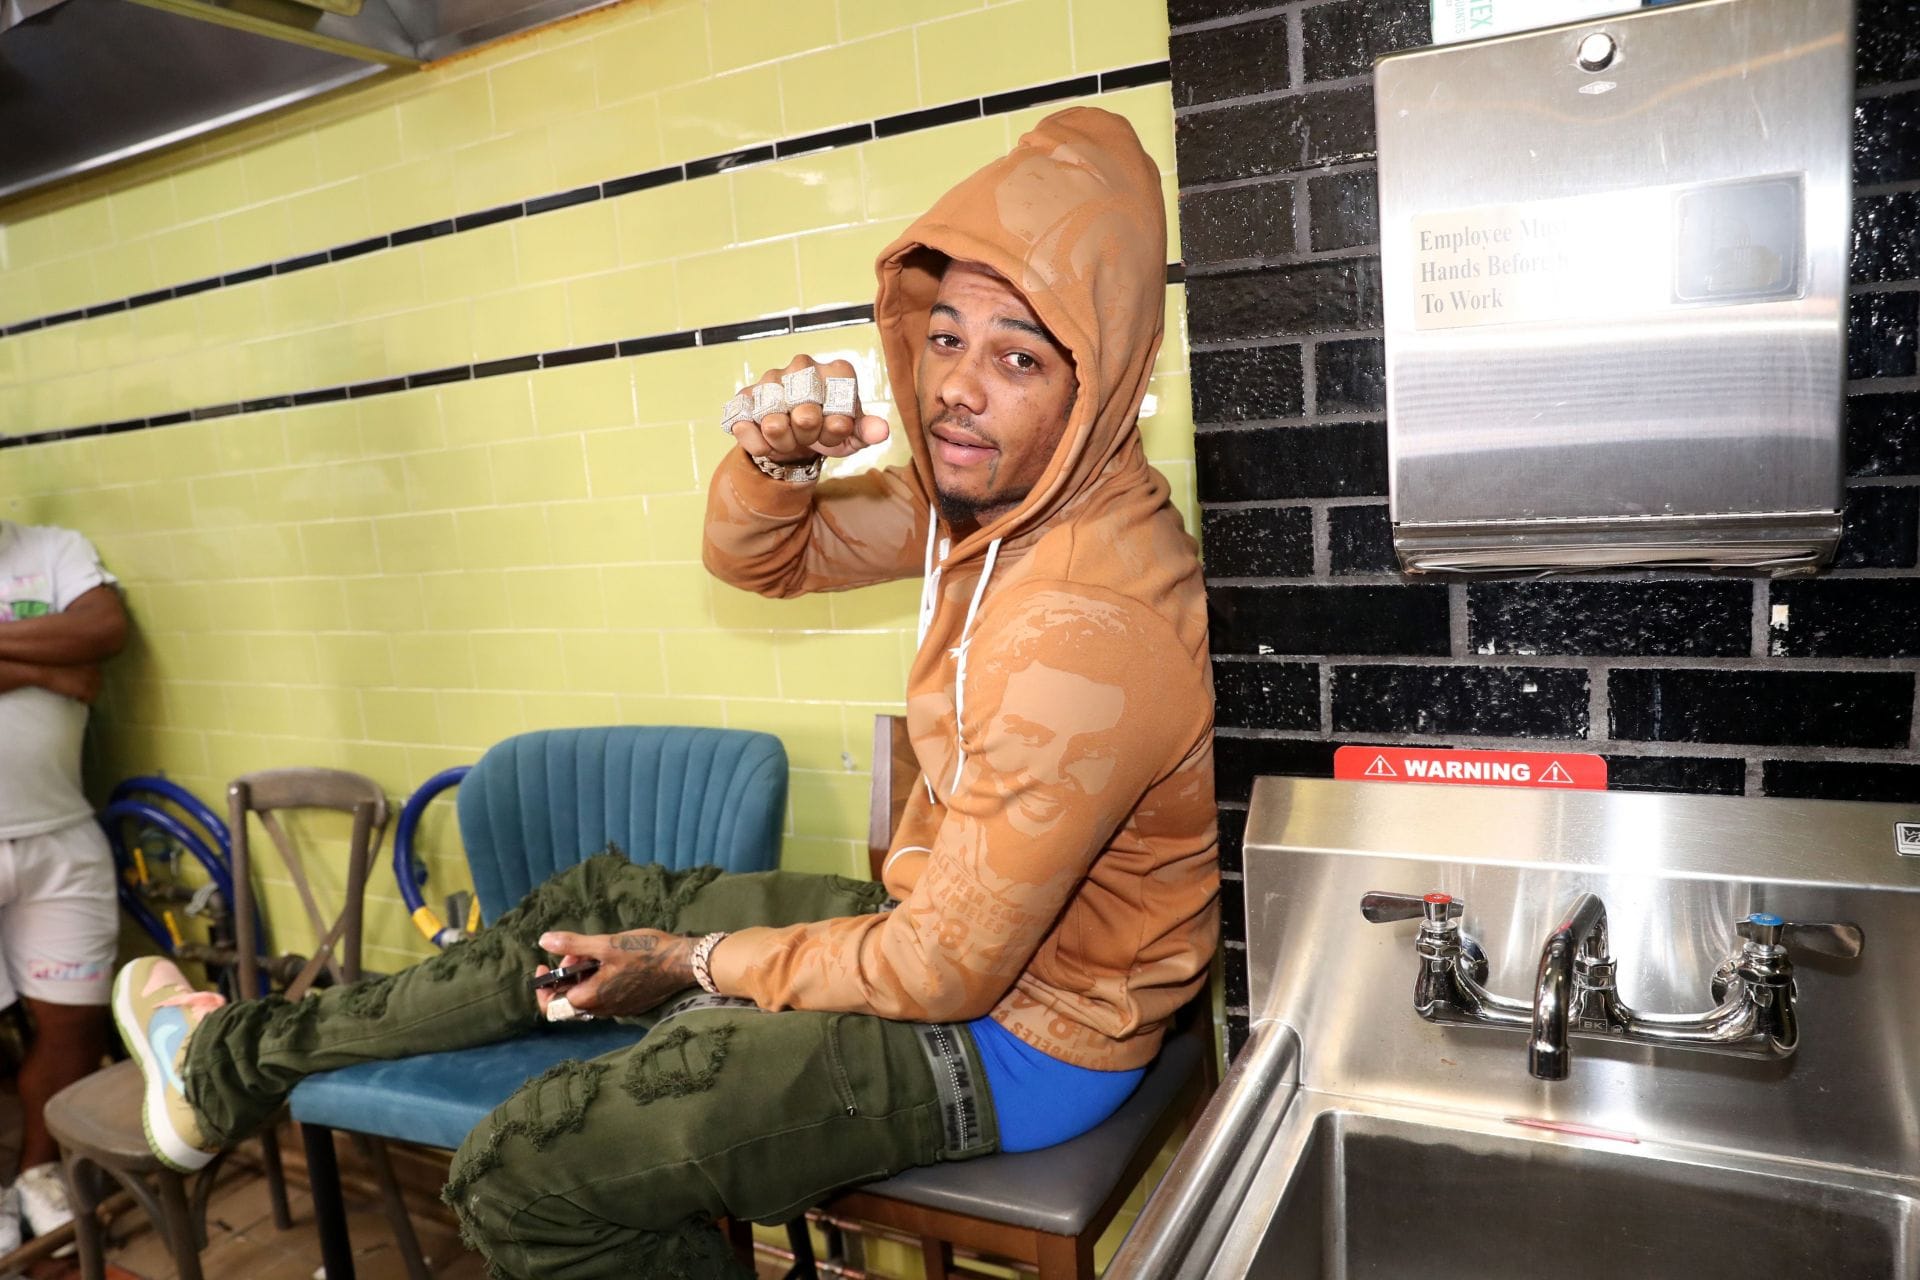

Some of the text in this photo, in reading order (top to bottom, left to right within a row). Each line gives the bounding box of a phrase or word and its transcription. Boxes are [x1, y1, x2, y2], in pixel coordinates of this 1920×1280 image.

[1420, 226, 1512, 254] Employee
[1421, 259, 1481, 283] Hands
[1421, 288, 1504, 314] To Work
[1404, 760, 1531, 781] WARNING
[1584, 1021, 1603, 1030] BK
